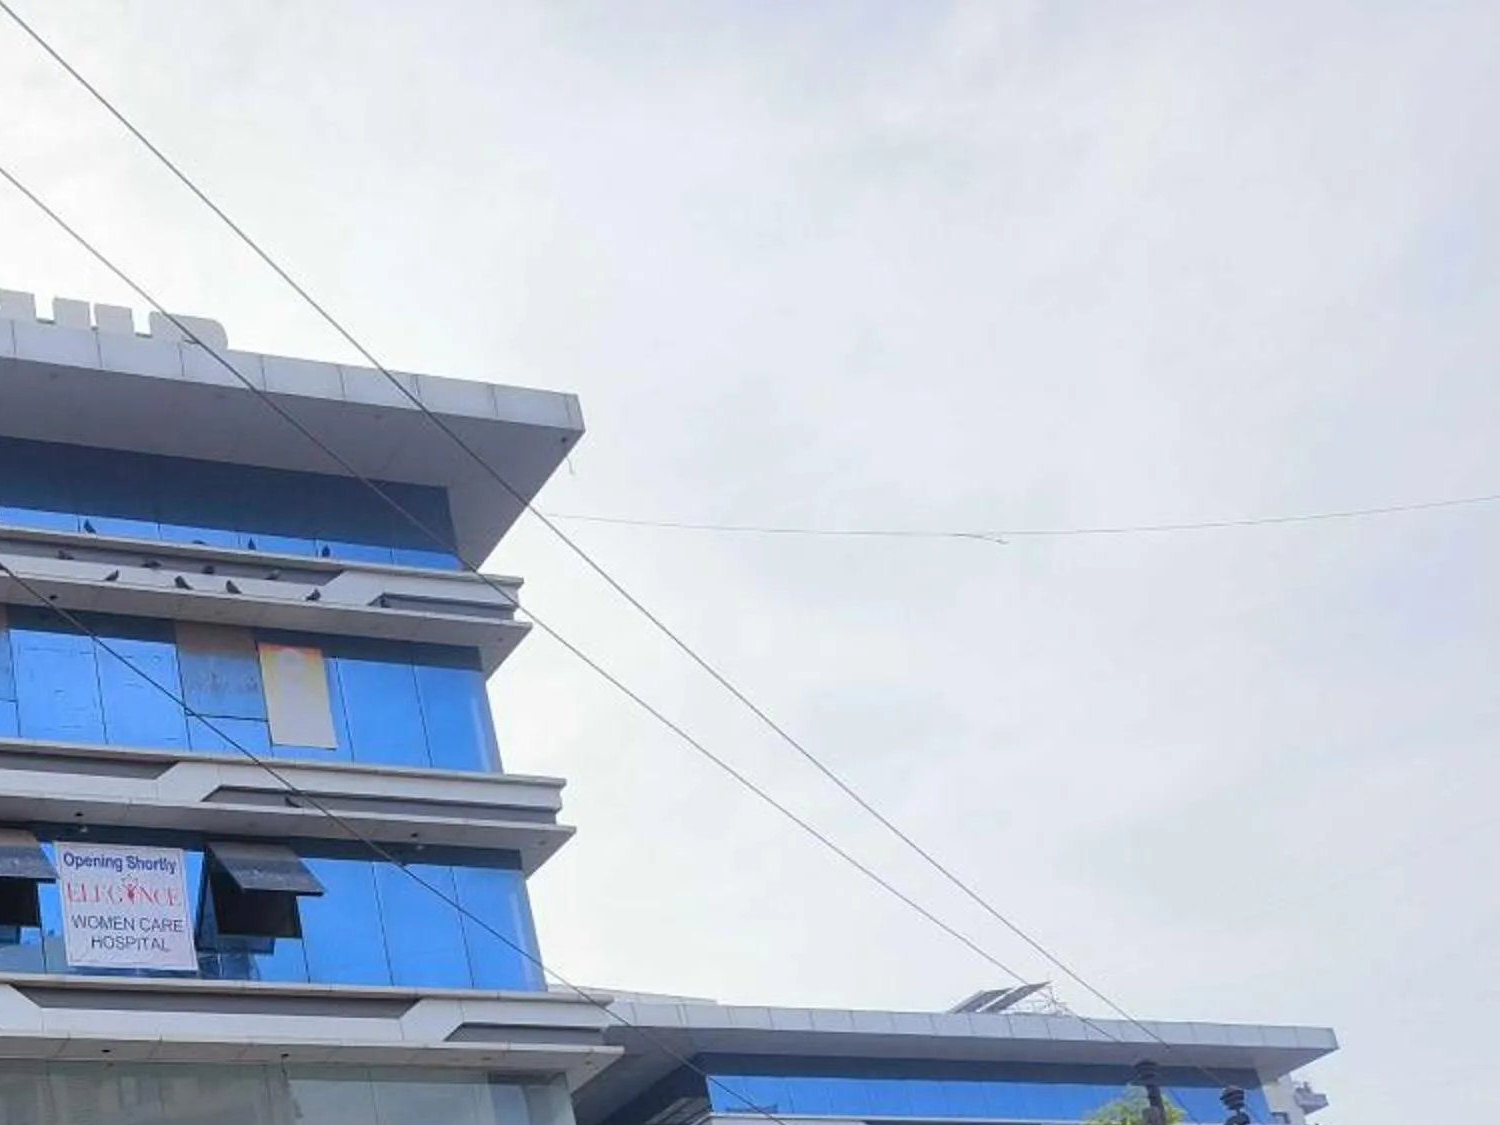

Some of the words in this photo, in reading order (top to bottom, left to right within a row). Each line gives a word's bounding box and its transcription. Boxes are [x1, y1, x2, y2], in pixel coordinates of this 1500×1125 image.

[63, 851, 124, 873] Opening
[126, 855, 177, 875] Shortly
[71, 914, 136, 932] WOMEN
[139, 915, 185, 933] CARE
[91, 935, 169, 952] HOSPITAL
